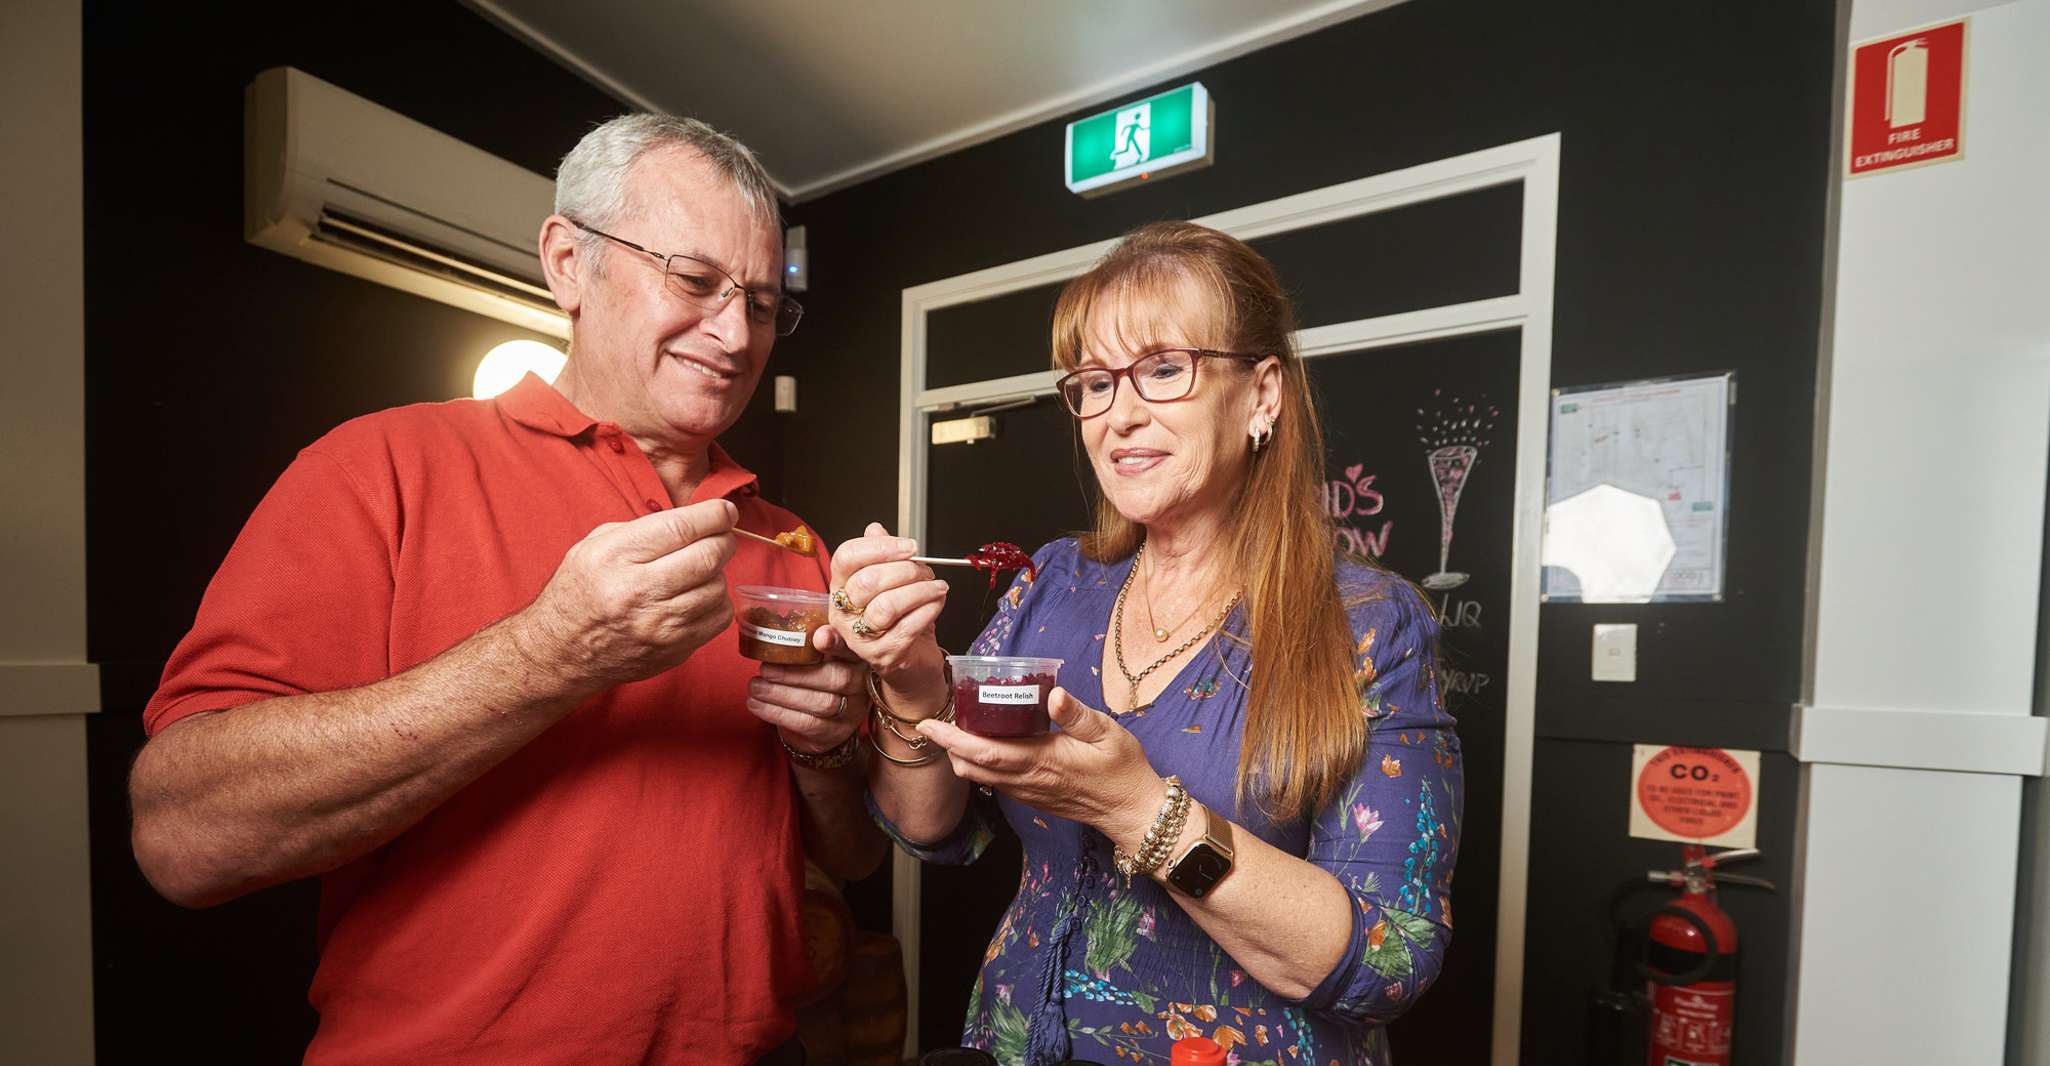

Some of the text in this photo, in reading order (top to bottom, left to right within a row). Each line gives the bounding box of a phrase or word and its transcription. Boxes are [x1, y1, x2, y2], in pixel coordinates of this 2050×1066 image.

[1888, 128, 1921, 145] FIRE
[1855, 138, 1955, 168] EXTINGUISHER
[758, 631, 776, 639] Mango
[1439, 667, 1491, 694] YRUP
[982, 691, 1034, 700] Beetroot Relish
